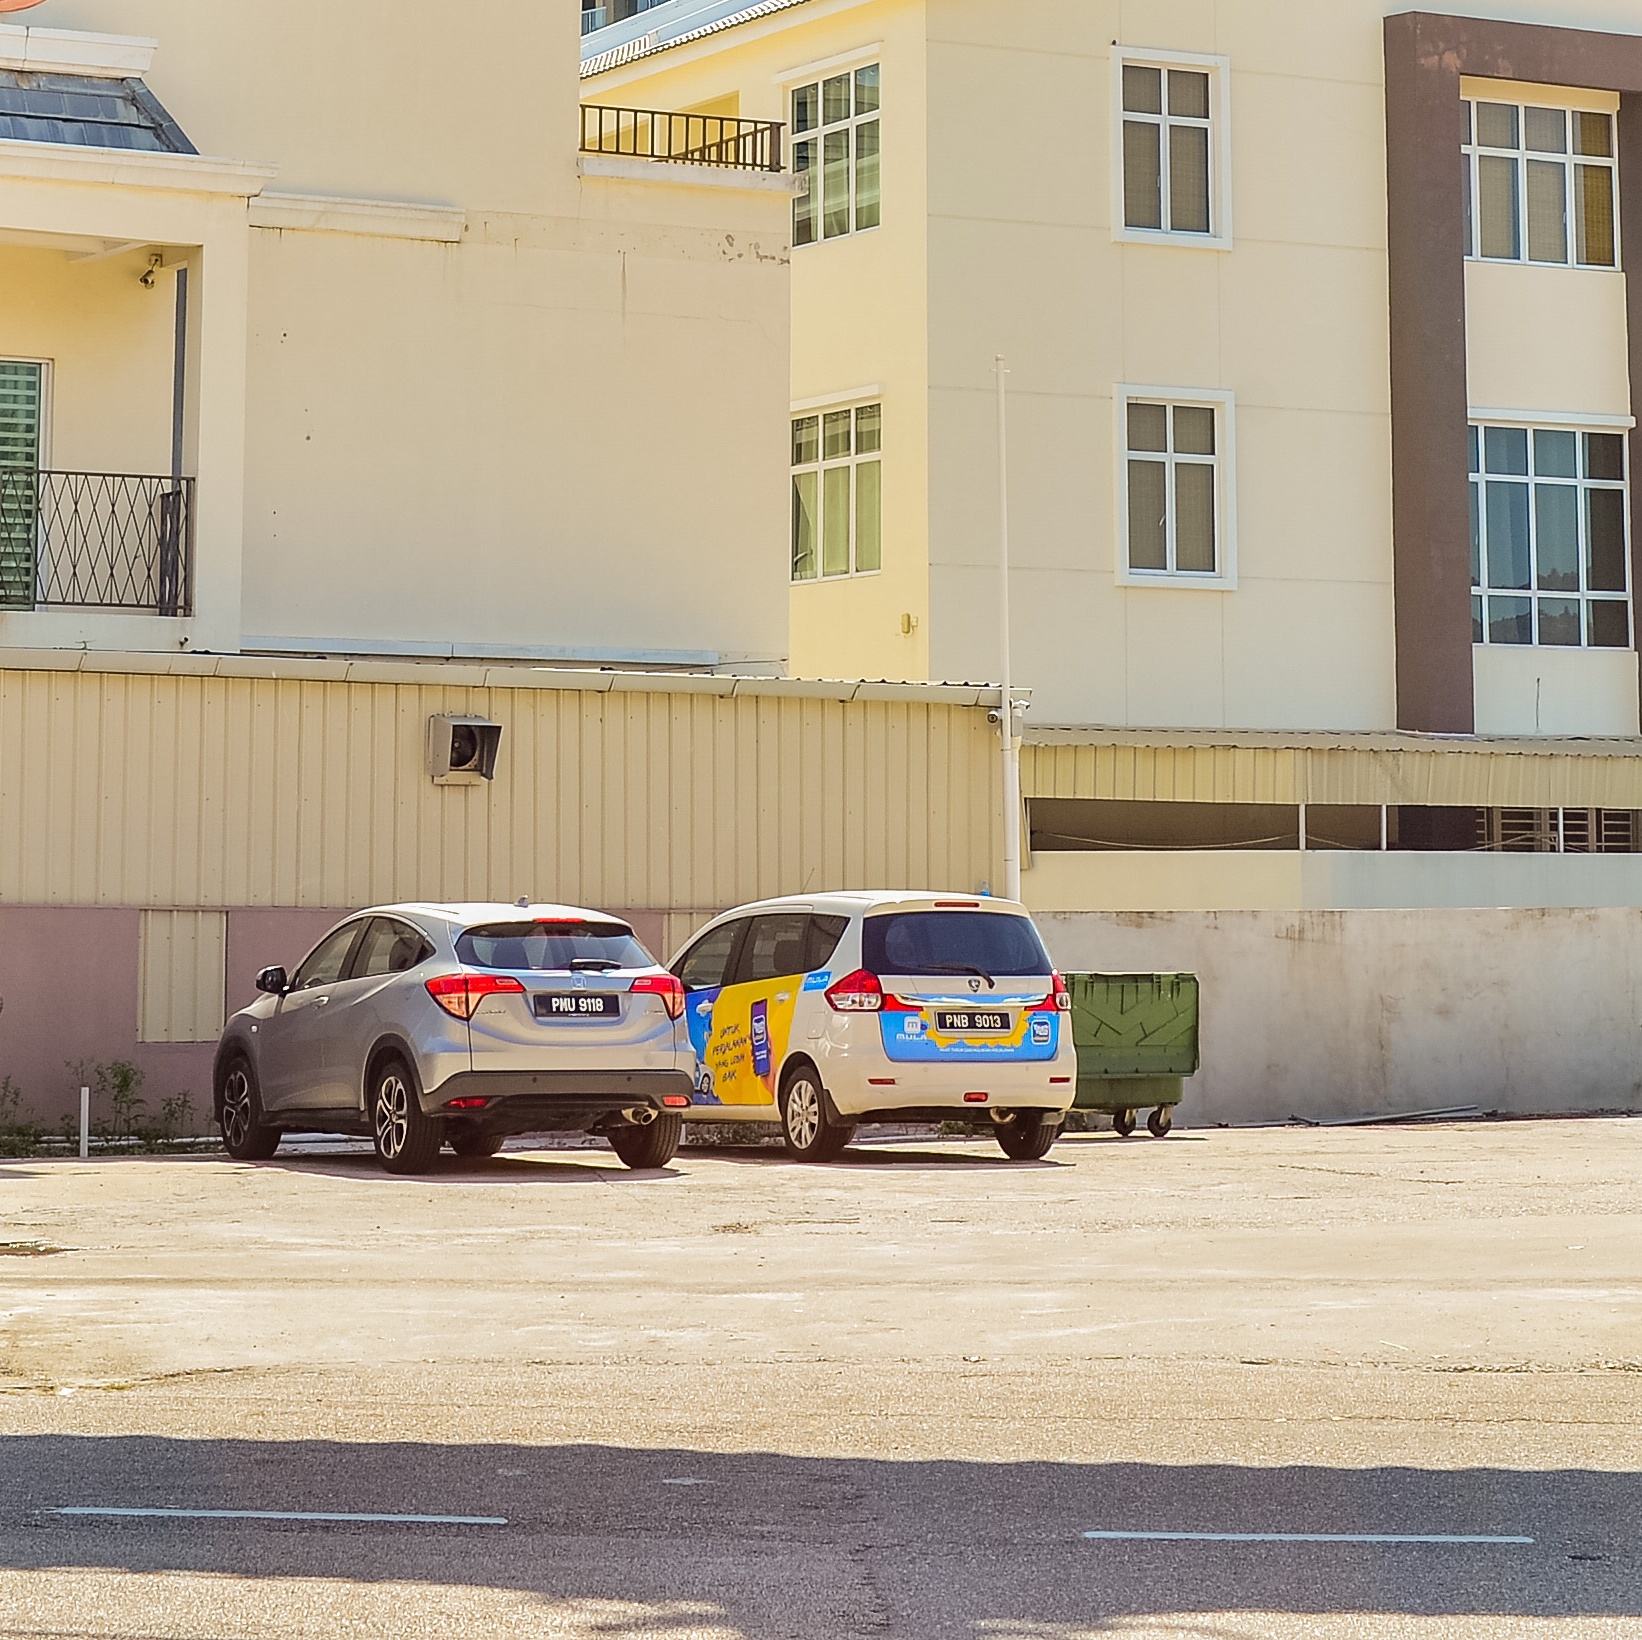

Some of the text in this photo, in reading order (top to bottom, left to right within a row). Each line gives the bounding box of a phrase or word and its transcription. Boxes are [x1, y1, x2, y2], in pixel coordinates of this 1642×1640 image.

[551, 997, 604, 1012] PMU 9118
[945, 1014, 1002, 1028] PNB 9013
